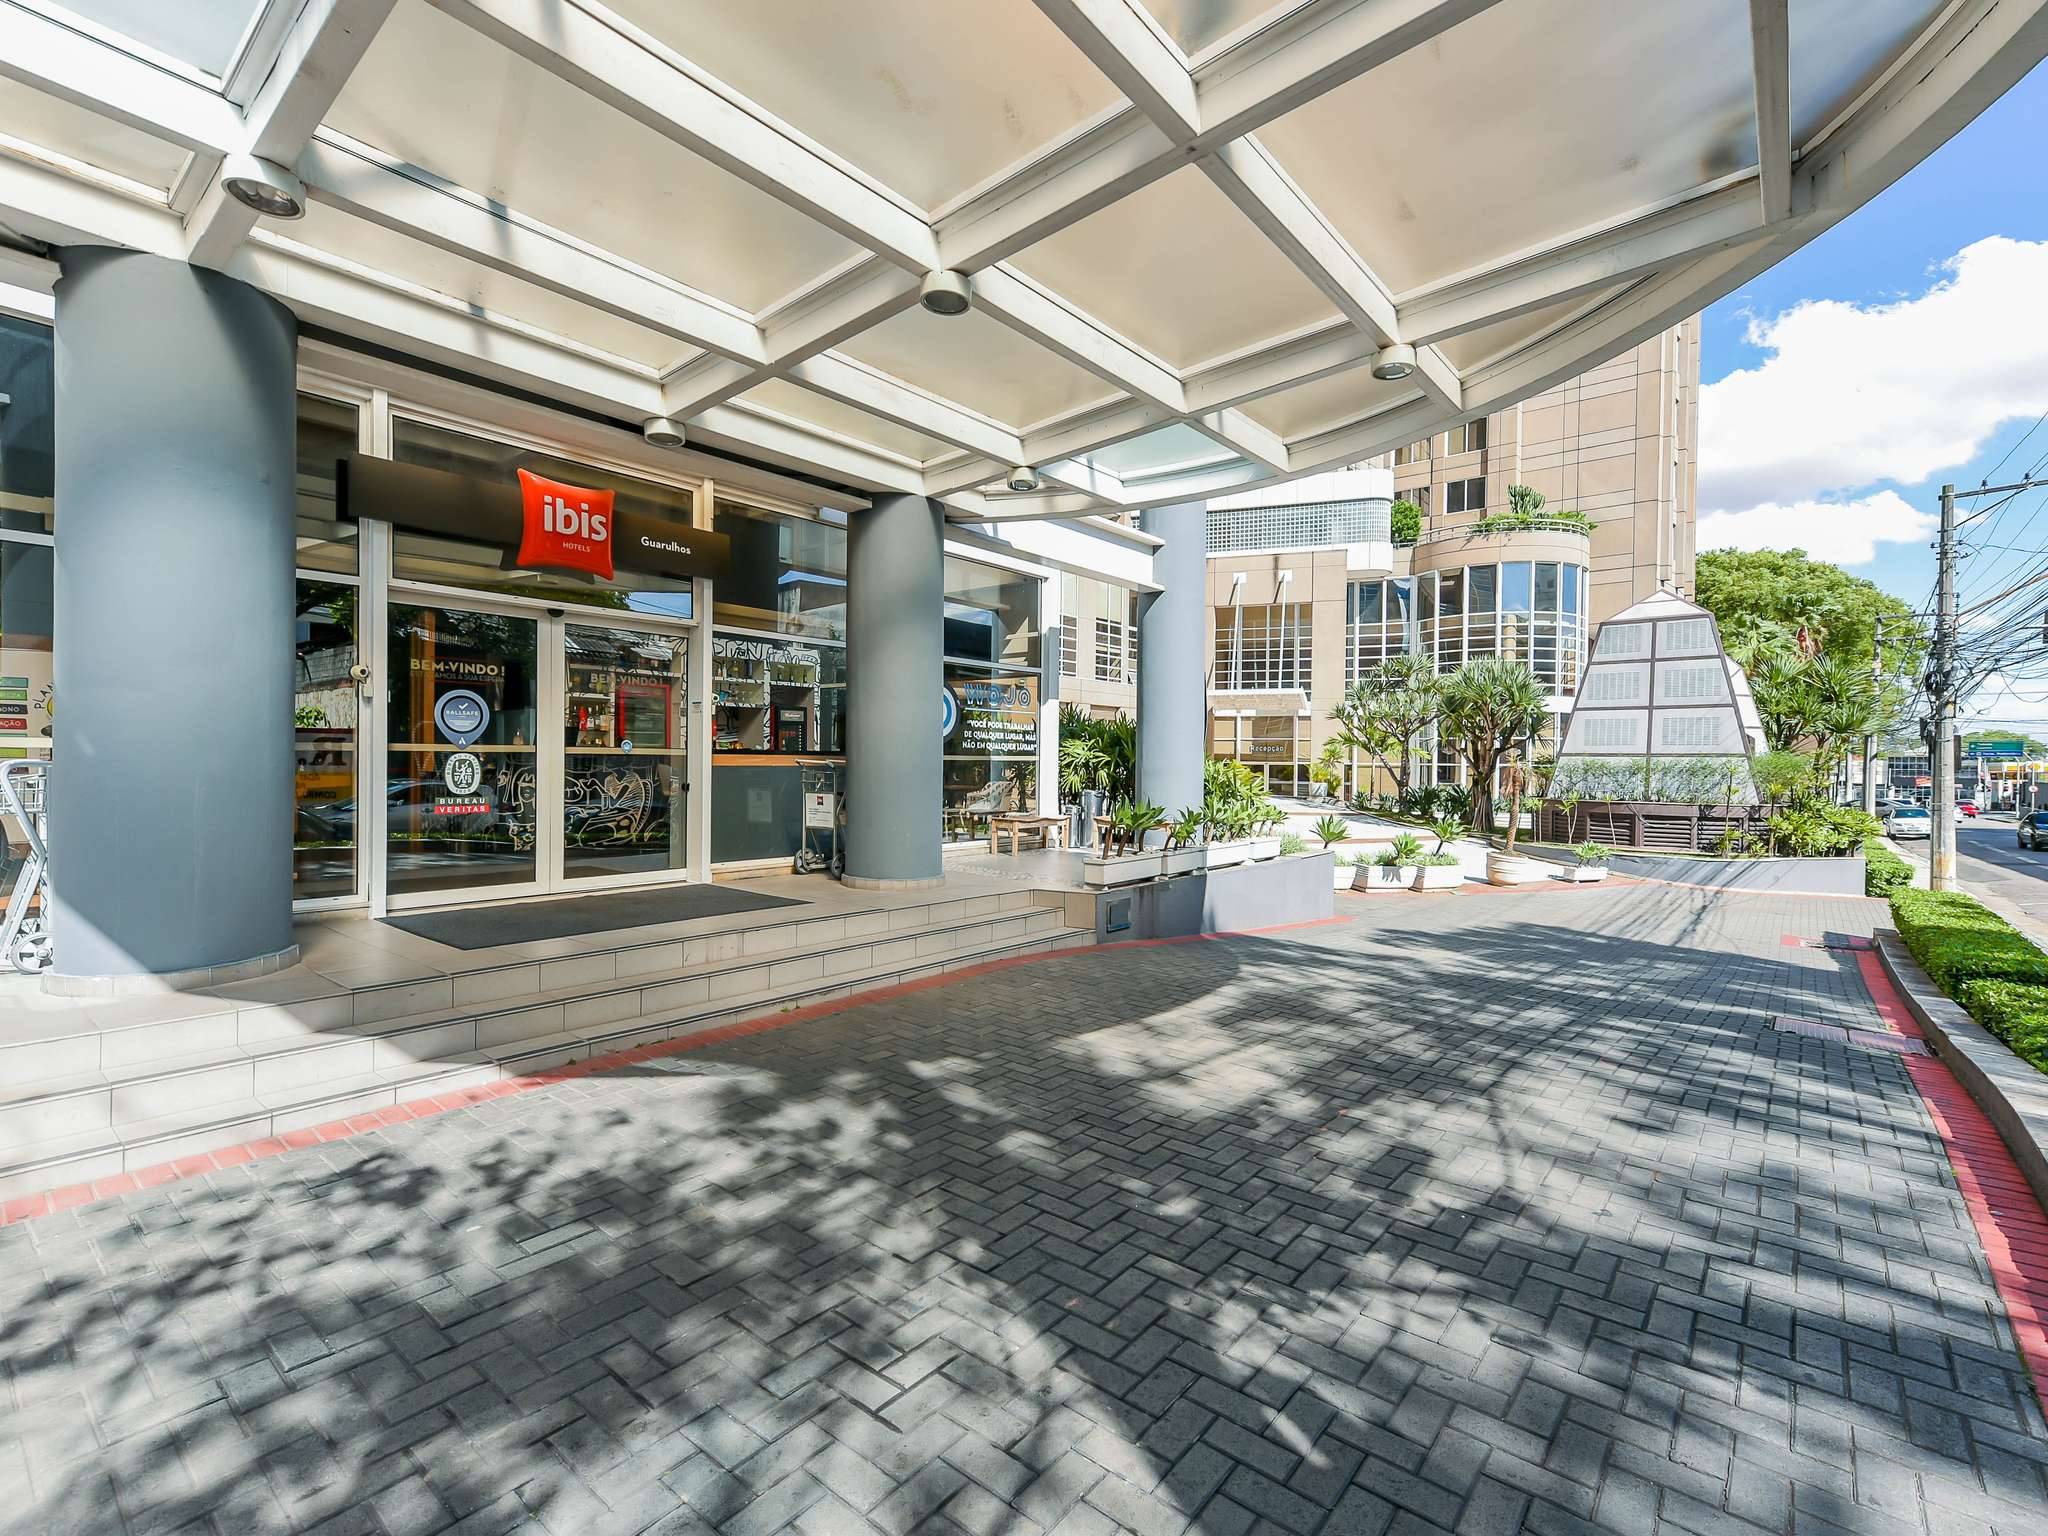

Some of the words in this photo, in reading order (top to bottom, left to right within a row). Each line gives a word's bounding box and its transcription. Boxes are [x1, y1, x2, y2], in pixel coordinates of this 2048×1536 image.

[543, 495, 608, 541] ibis
[562, 542, 591, 553] HOTELS
[640, 536, 691, 555] Guarulhos
[963, 683, 1031, 708] WOJO
[988, 721, 1003, 729] PODE
[973, 731, 1004, 740] QUALQUER
[962, 740, 976, 749] NÃO
[986, 742, 1016, 751] QUALQUER
[1250, 744, 1284, 753] Recepção
[439, 805, 486, 813] VERITAS
